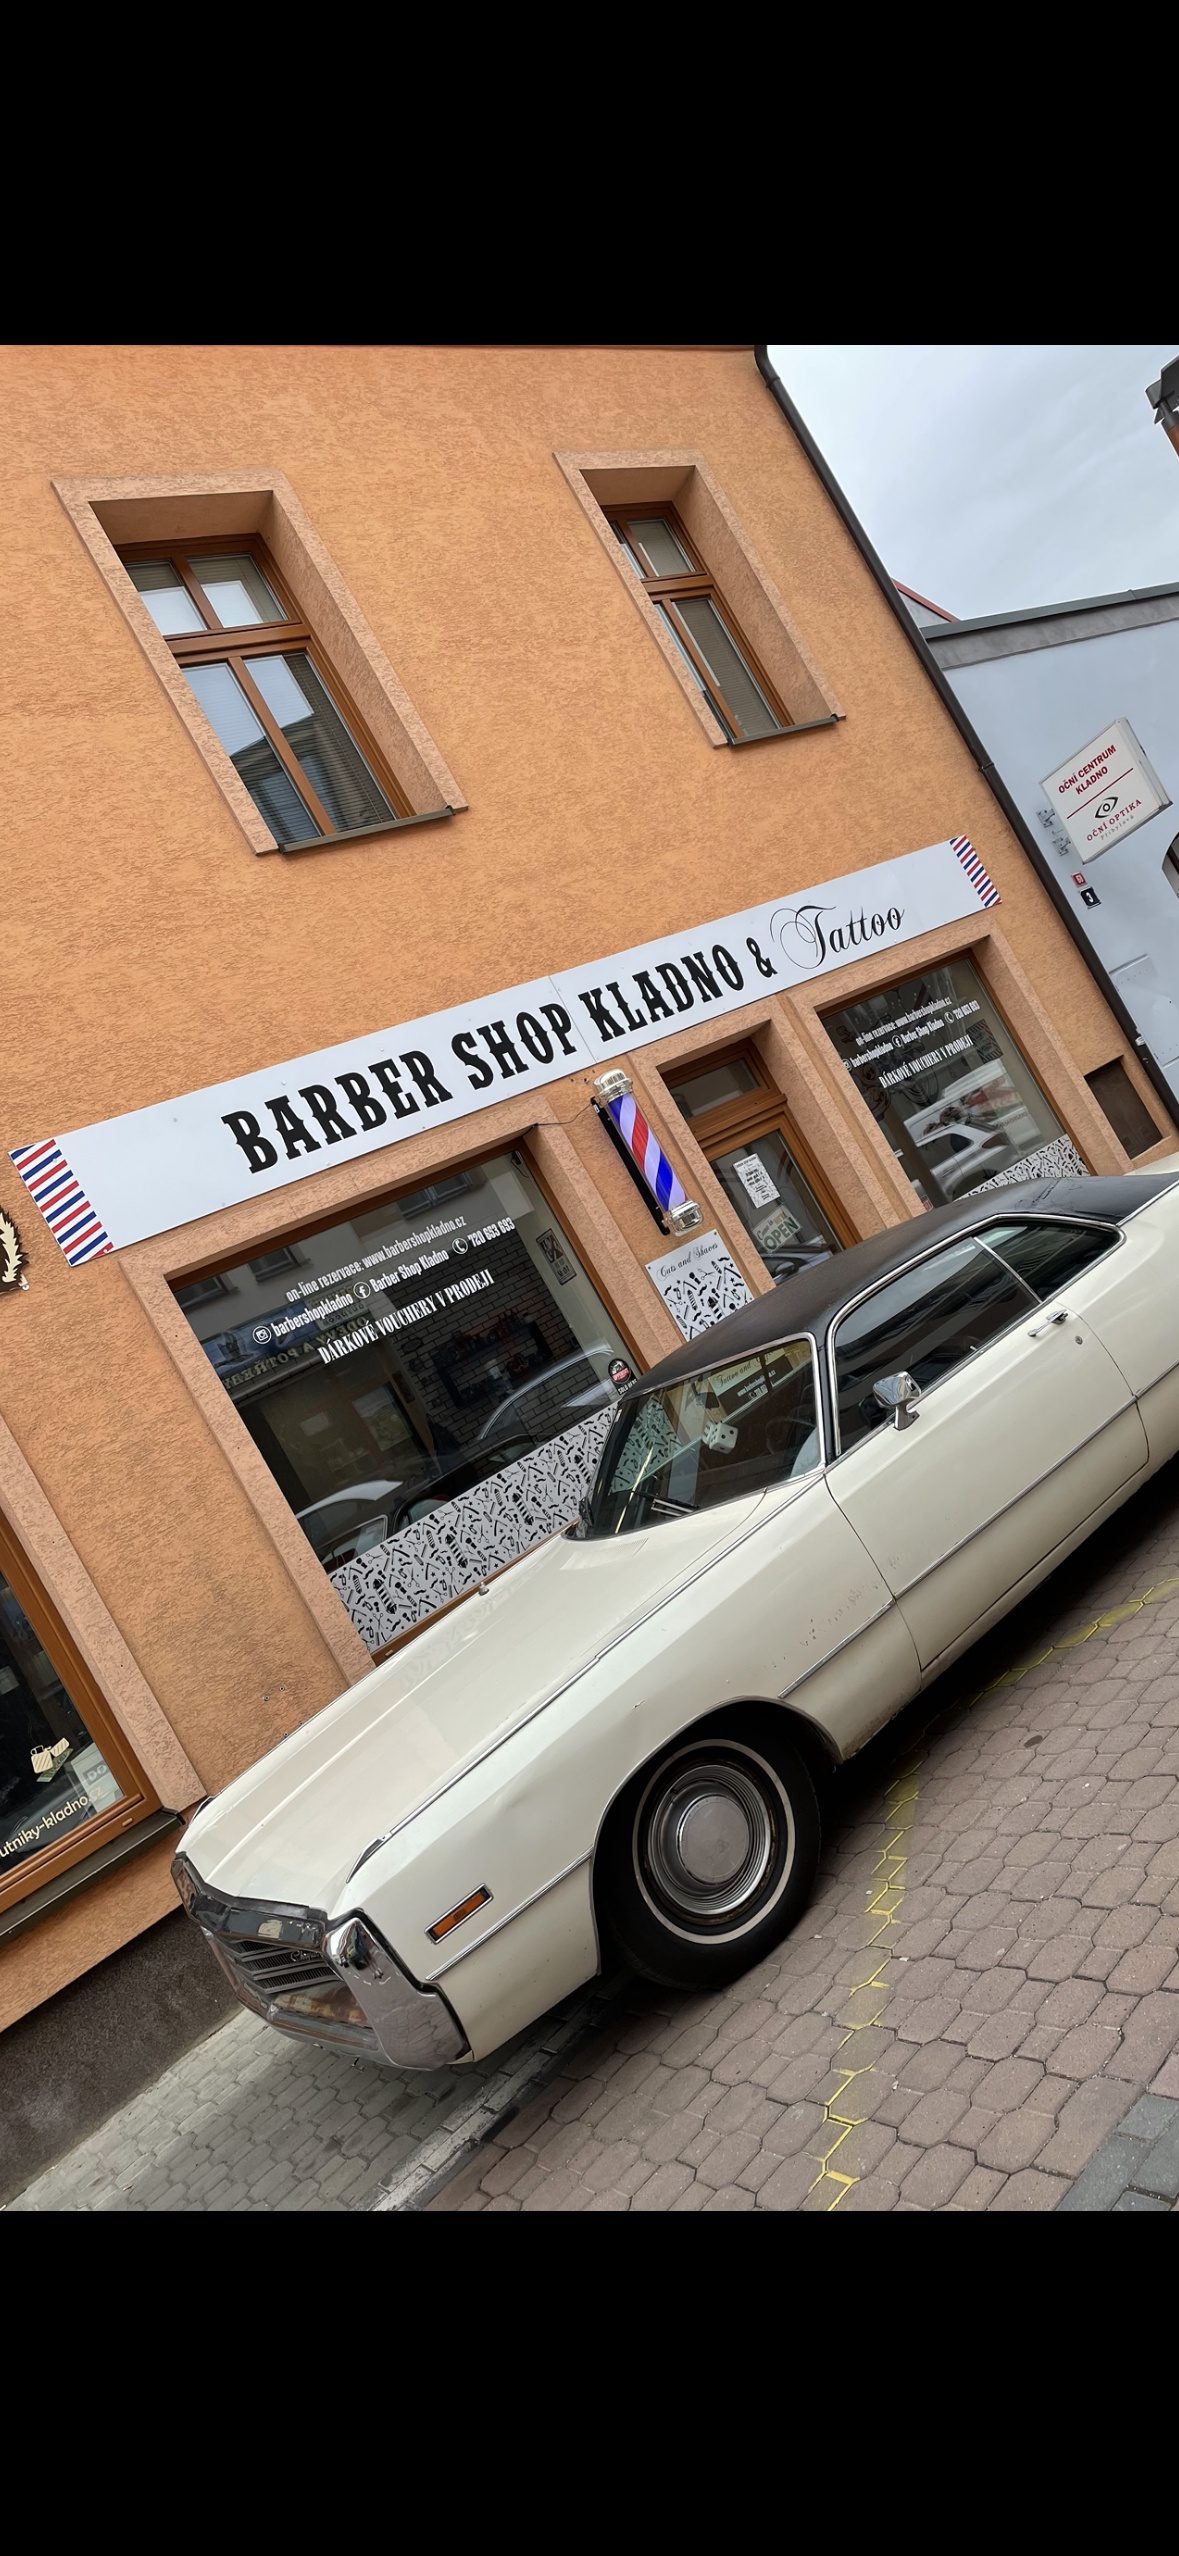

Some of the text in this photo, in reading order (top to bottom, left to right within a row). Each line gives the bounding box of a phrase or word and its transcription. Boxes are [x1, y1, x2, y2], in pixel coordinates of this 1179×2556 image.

[1058, 744, 1116, 793] OČNÍ CENTRUM
[1075, 766, 1109, 794] KLADNO
[1086, 799, 1142, 841] OČNÍ OPTIKA
[221, 905, 905, 1174] BARBER SHOP KLADNO & Tattoo
[900, 1018, 945, 1044] Barber Shop Kladno
[878, 1062, 912, 1089] DÁRKOVÉ
[908, 1049, 943, 1074] VOUCHERY
[940, 1047, 948, 1059] V
[944, 1034, 974, 1056] PRODEJI
[467, 1217, 515, 1248] 720 653 693
[763, 1216, 799, 1250] OPEN
[285, 1281, 320, 1302] on-line
[317, 1263, 365, 1288] rezervace:
[362, 1215, 467, 1269] www.barbershopkladno.cz
[369, 1249, 450, 1293] Barber Shop Kladno
[656, 1243, 718, 1282] Cuts and Shaves
[271, 1293, 354, 1337] barbershopkladno
[316, 1320, 379, 1365] DÁRKOVÉ
[375, 1296, 438, 1337] VOUCHERY
[435, 1291, 447, 1308] V
[444, 1269, 495, 1305] PRODEJI
[739, 1362, 752, 1374] and
